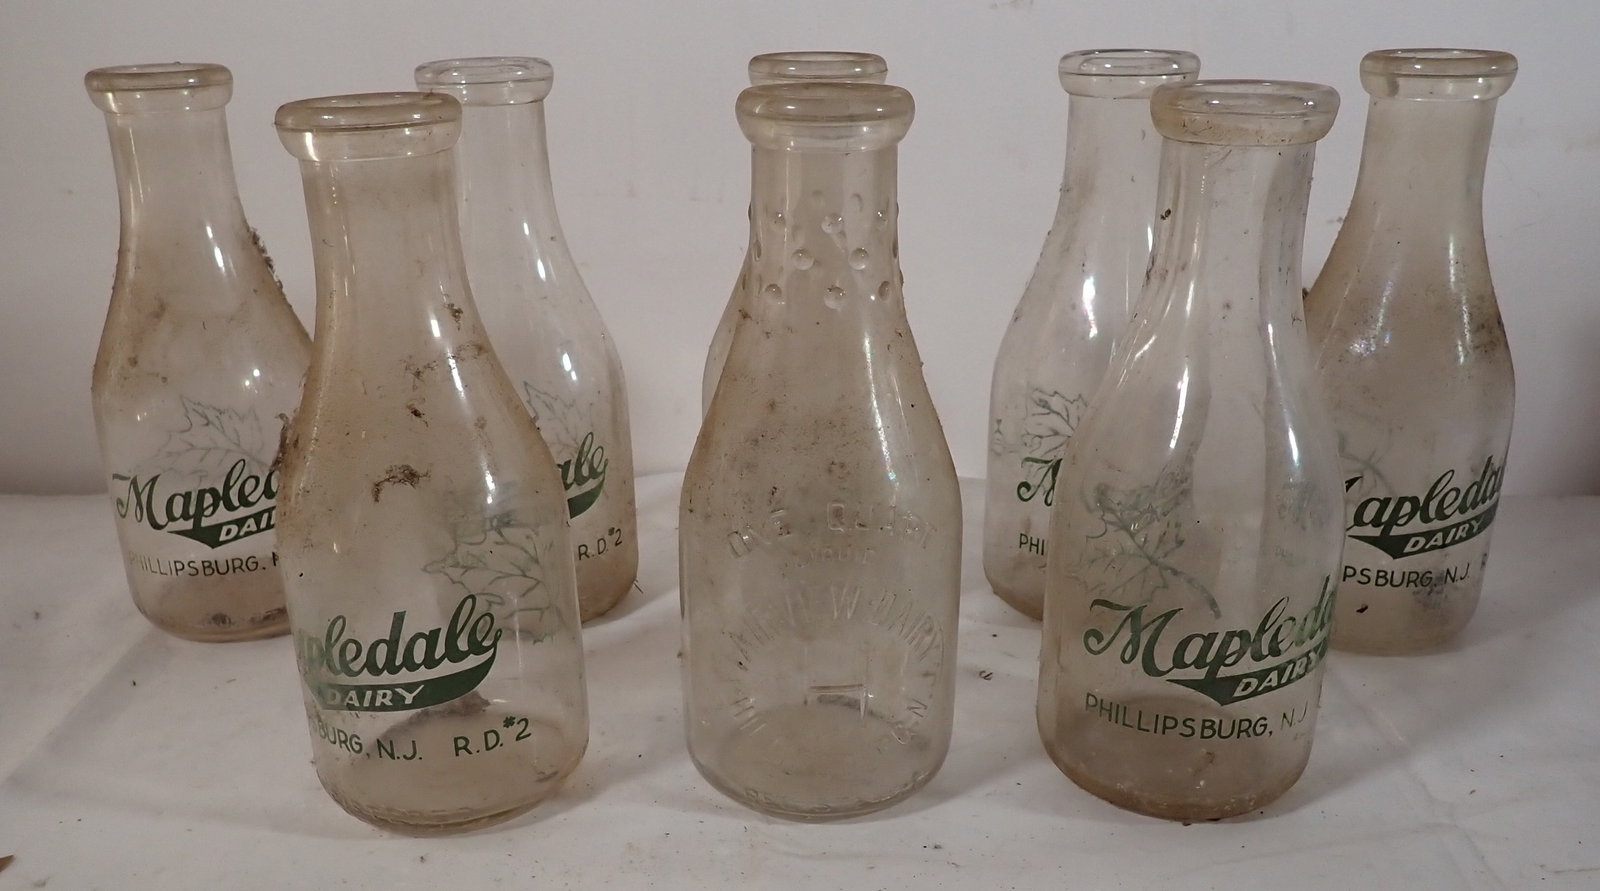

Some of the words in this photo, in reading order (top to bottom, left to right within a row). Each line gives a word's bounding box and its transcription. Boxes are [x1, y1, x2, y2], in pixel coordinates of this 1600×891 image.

[1403, 516, 1483, 553] DAIRY
[326, 684, 425, 707] DAIRY
[1085, 691, 1274, 739] PHILLIPSBURG,
[377, 738, 422, 760] N.J.
